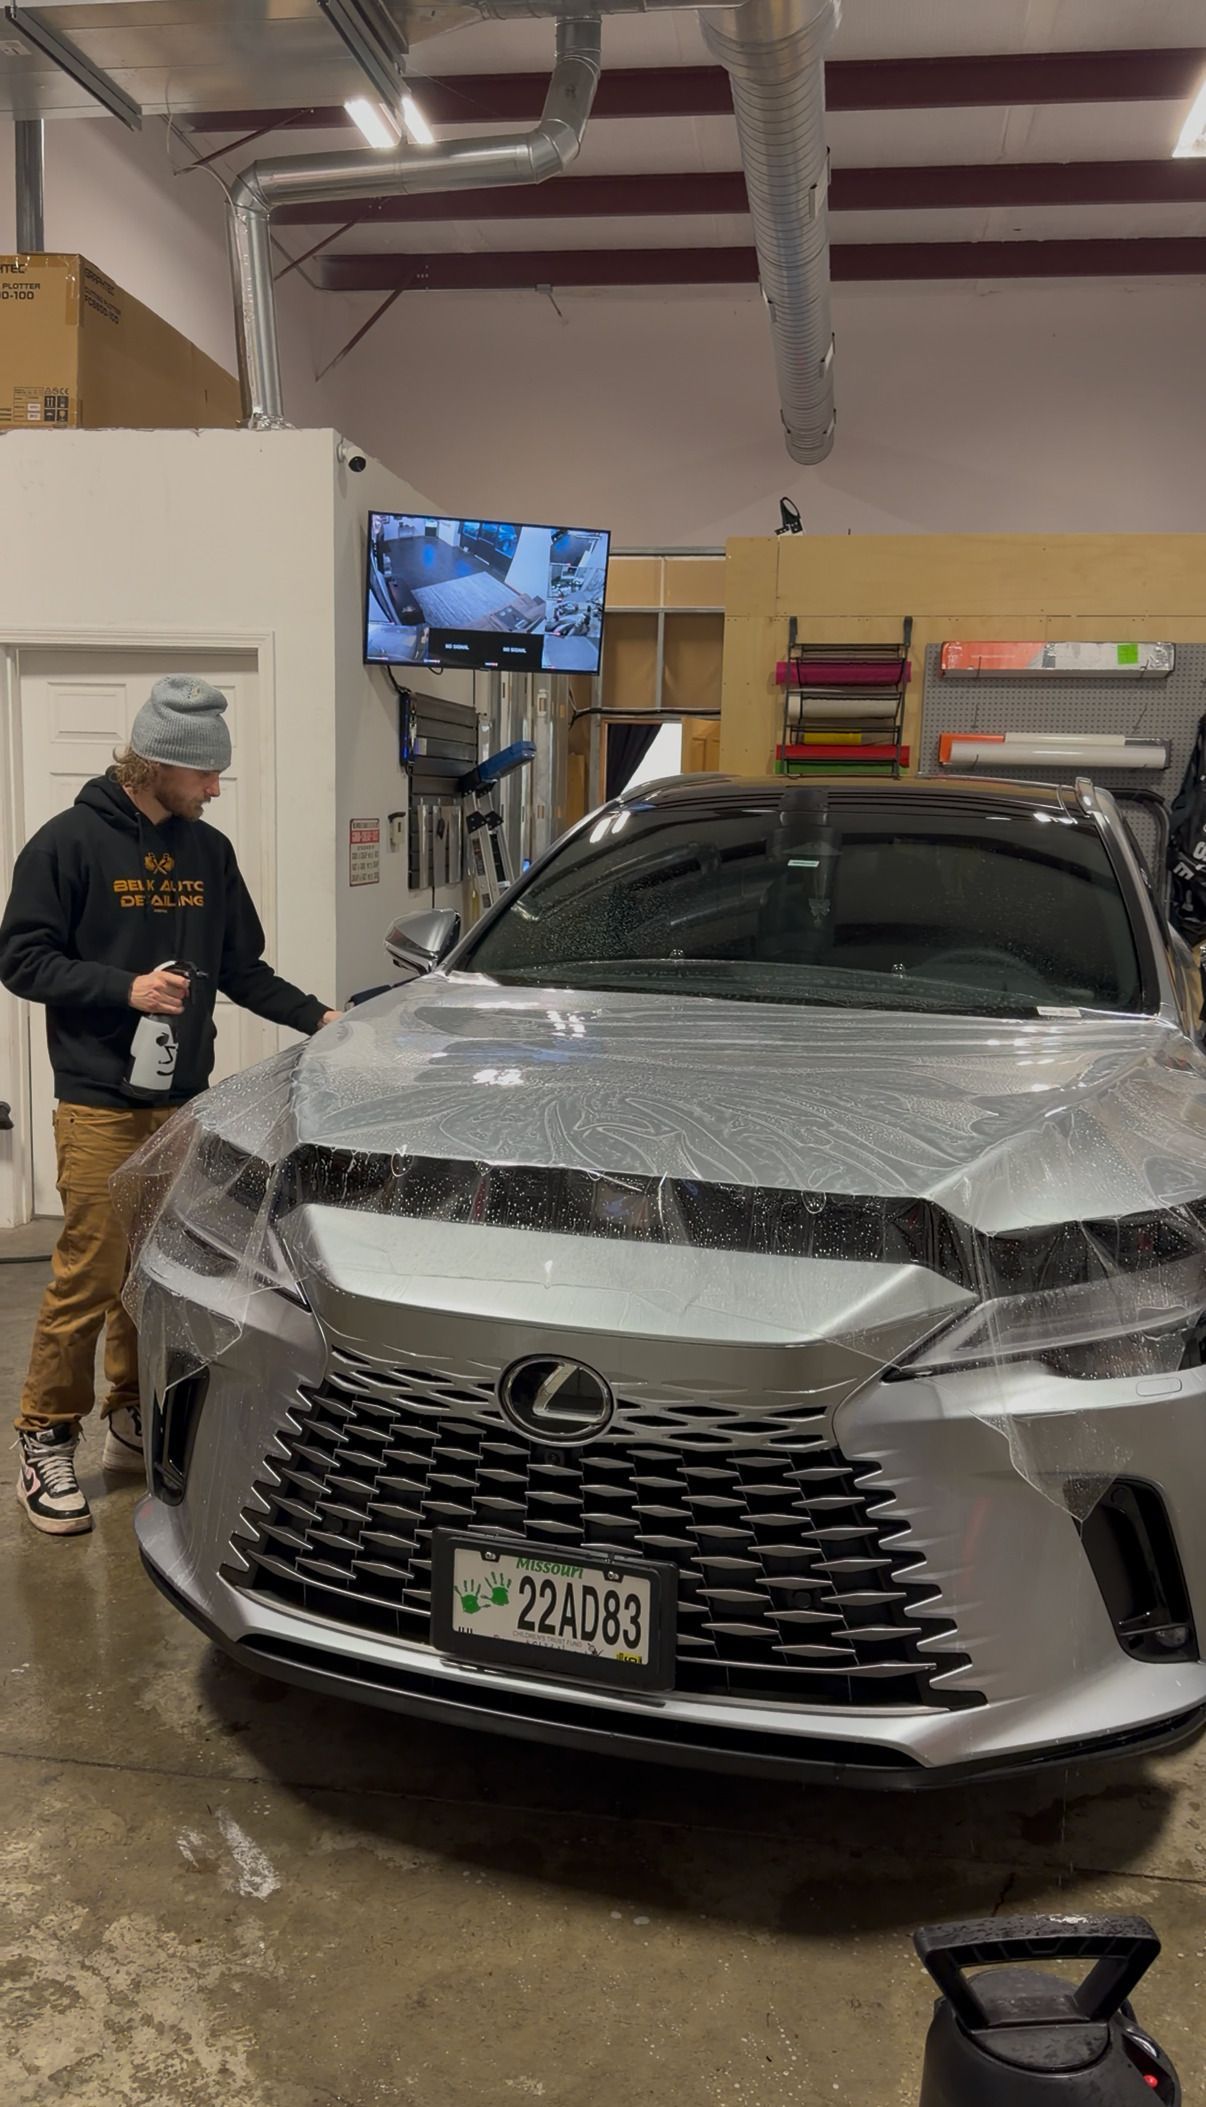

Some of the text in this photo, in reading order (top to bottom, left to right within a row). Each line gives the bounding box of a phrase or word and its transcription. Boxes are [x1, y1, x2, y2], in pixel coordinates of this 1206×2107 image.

[2, 282, 41, 290] PLOTTER
[0, 291, 35, 300] 0-100
[119, 894, 205, 907] DEAILING
[516, 1557, 584, 1579] Missouri
[517, 1575, 642, 1649] 22AD83
